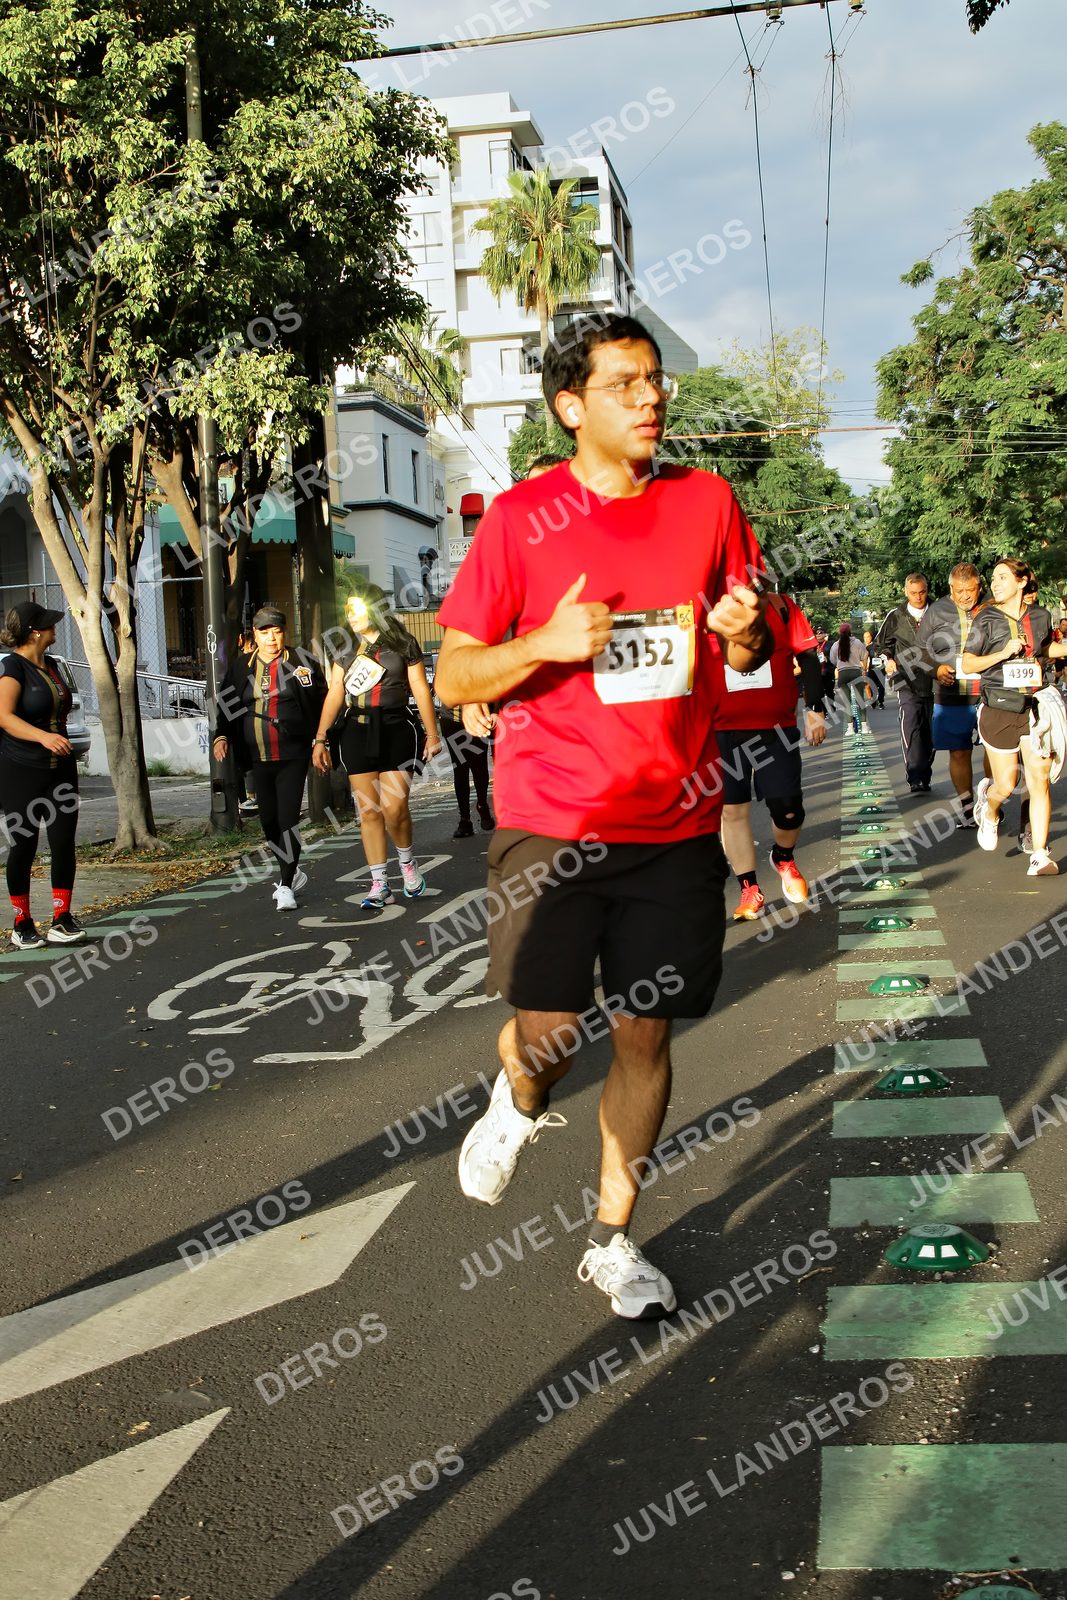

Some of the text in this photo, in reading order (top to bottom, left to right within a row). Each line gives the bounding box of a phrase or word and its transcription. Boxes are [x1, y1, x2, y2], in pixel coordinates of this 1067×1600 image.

[608, 637, 674, 670] 5152
[351, 667, 372, 690] 1222
[1008, 667, 1034, 679] 4399
